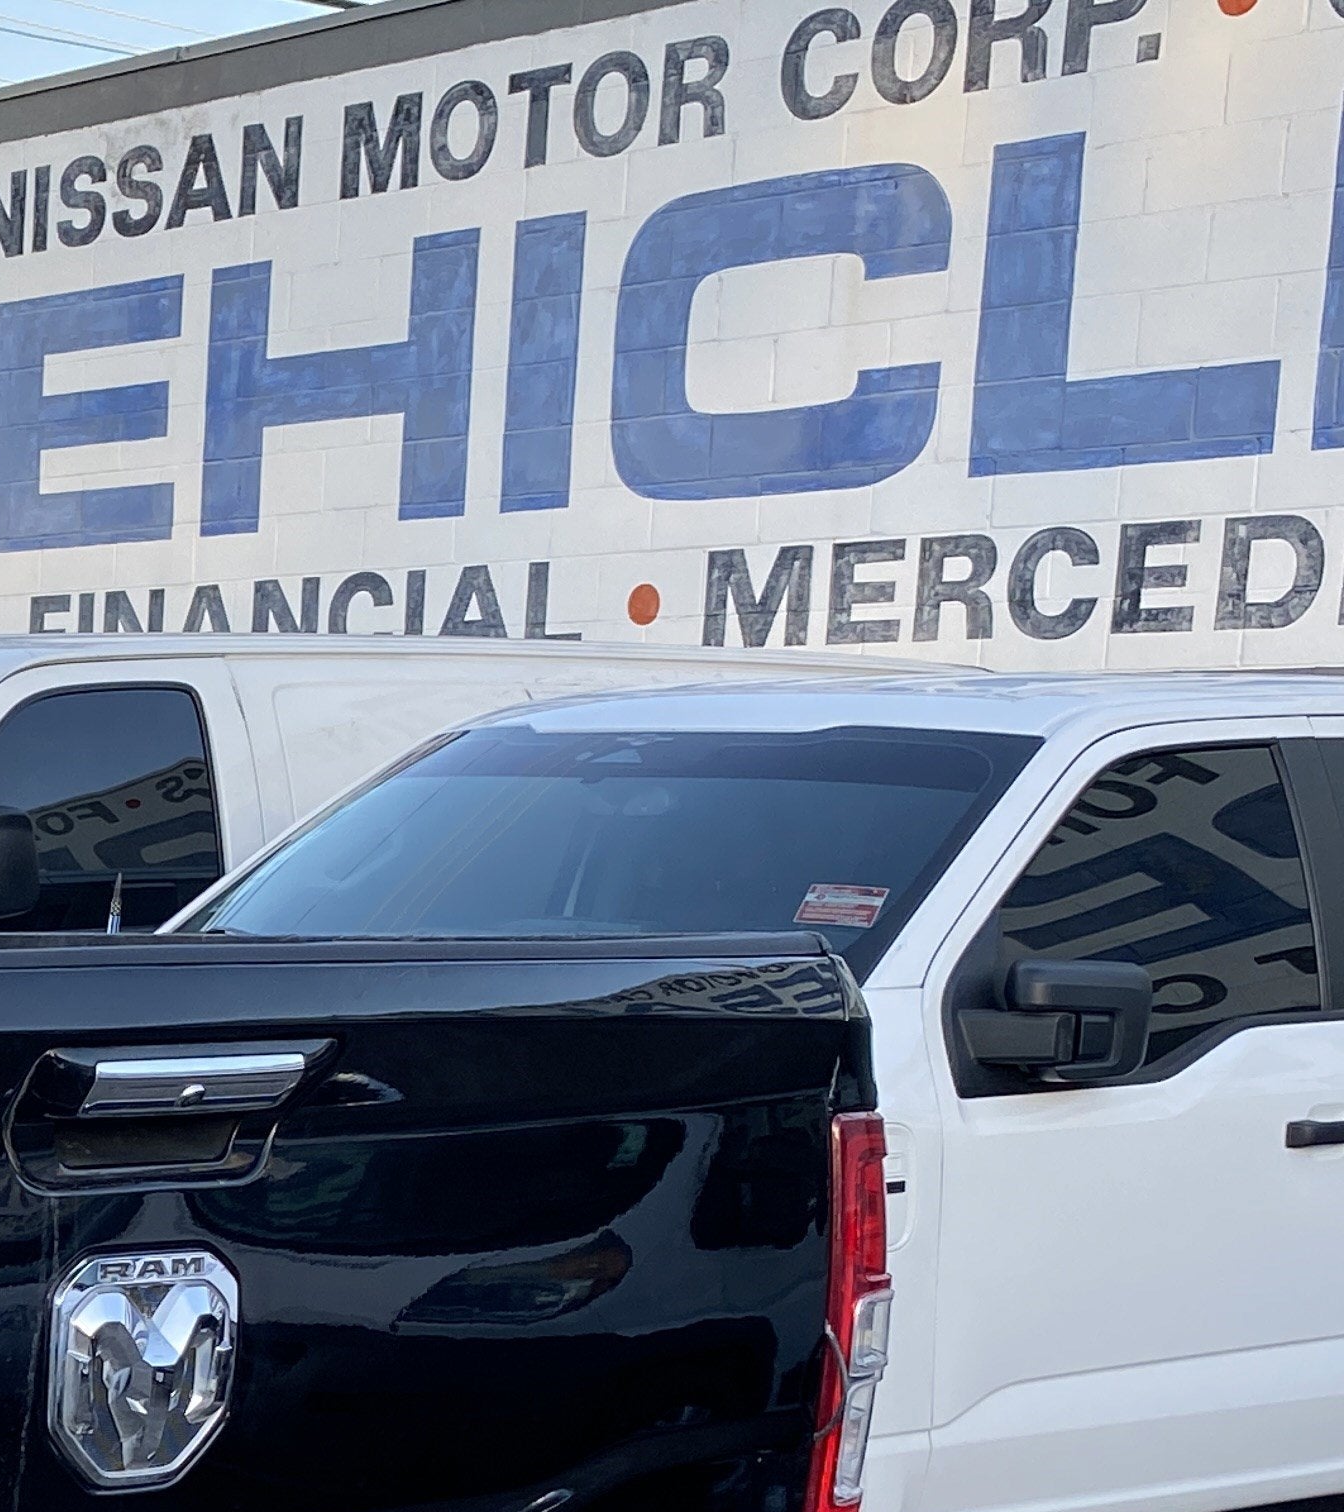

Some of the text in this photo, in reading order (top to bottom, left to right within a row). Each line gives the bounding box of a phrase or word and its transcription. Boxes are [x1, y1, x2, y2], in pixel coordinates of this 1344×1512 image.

[340, 35, 731, 200] MOTOR
[29, 561, 583, 641] FINANCIAL
[702, 514, 1344, 647] MERCED
[98, 1256, 206, 1280] RAM
